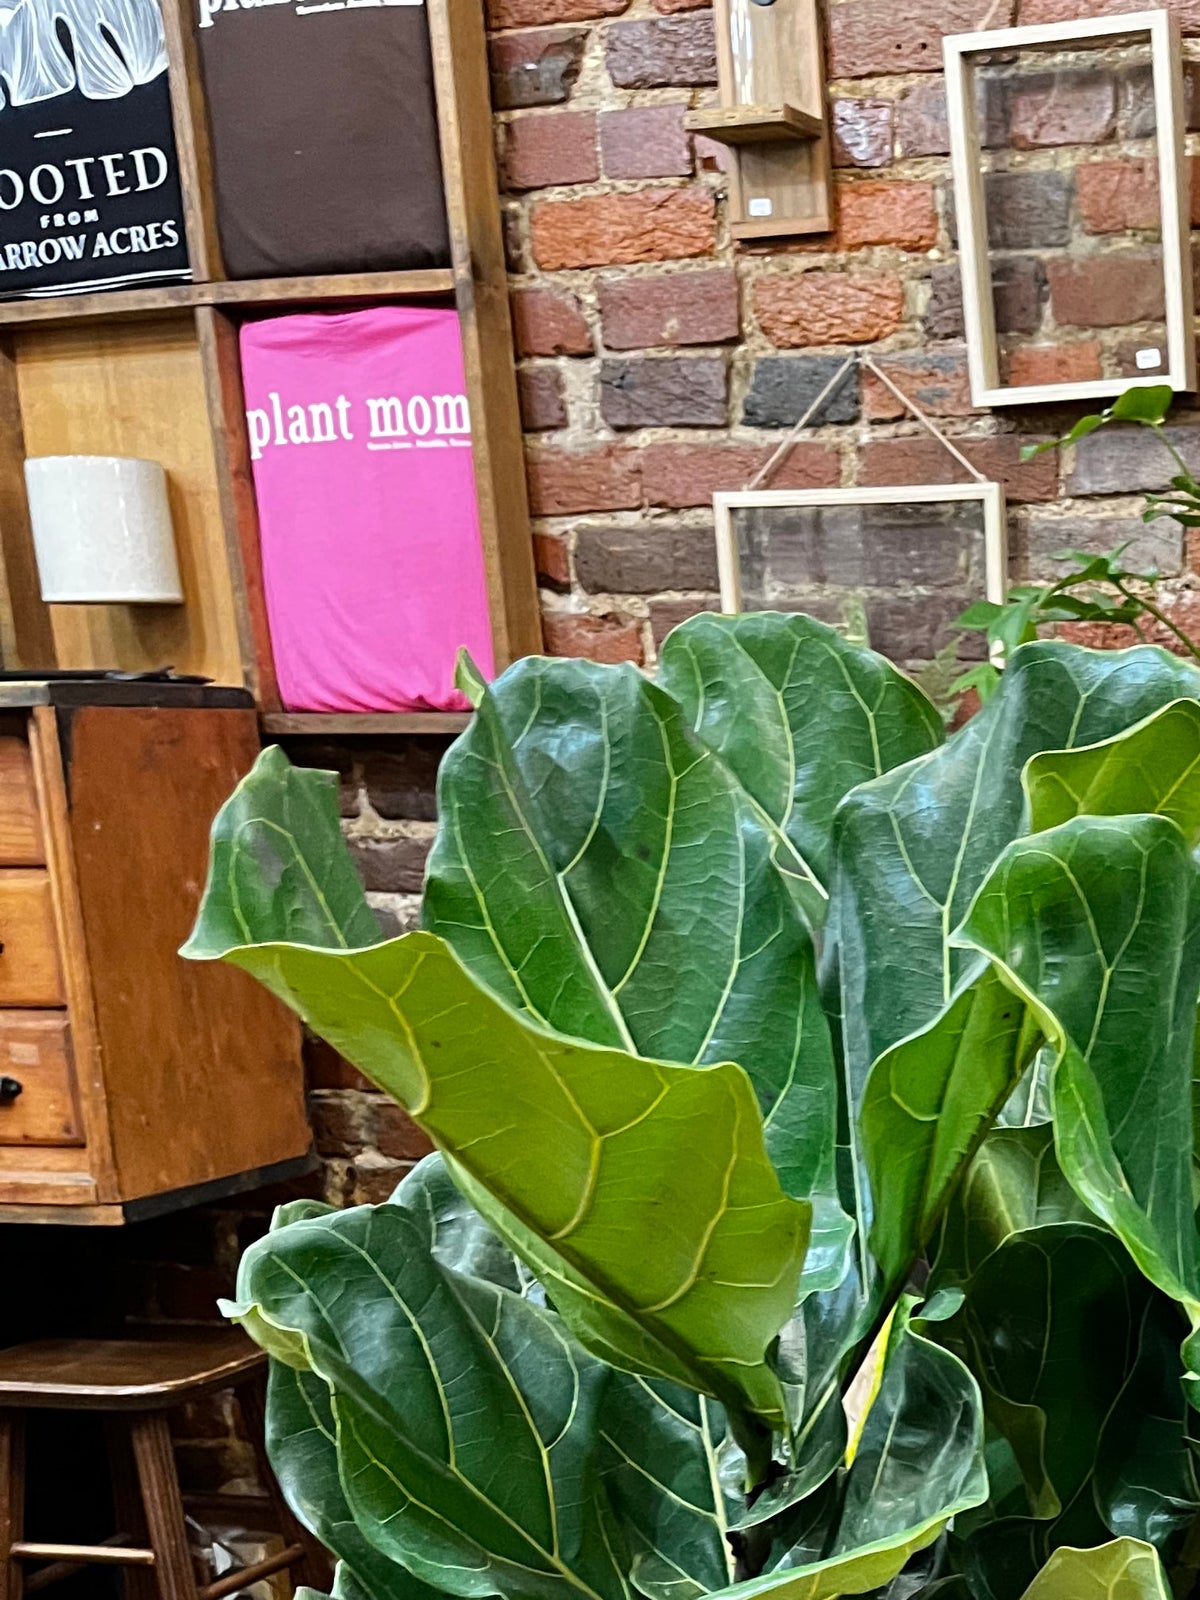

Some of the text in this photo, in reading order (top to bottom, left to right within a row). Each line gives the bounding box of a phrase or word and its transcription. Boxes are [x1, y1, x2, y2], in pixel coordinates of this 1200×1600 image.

[40, 209, 99, 229] FROM
[92, 220, 179, 258] ACRES
[246, 392, 471, 460] plant mom
